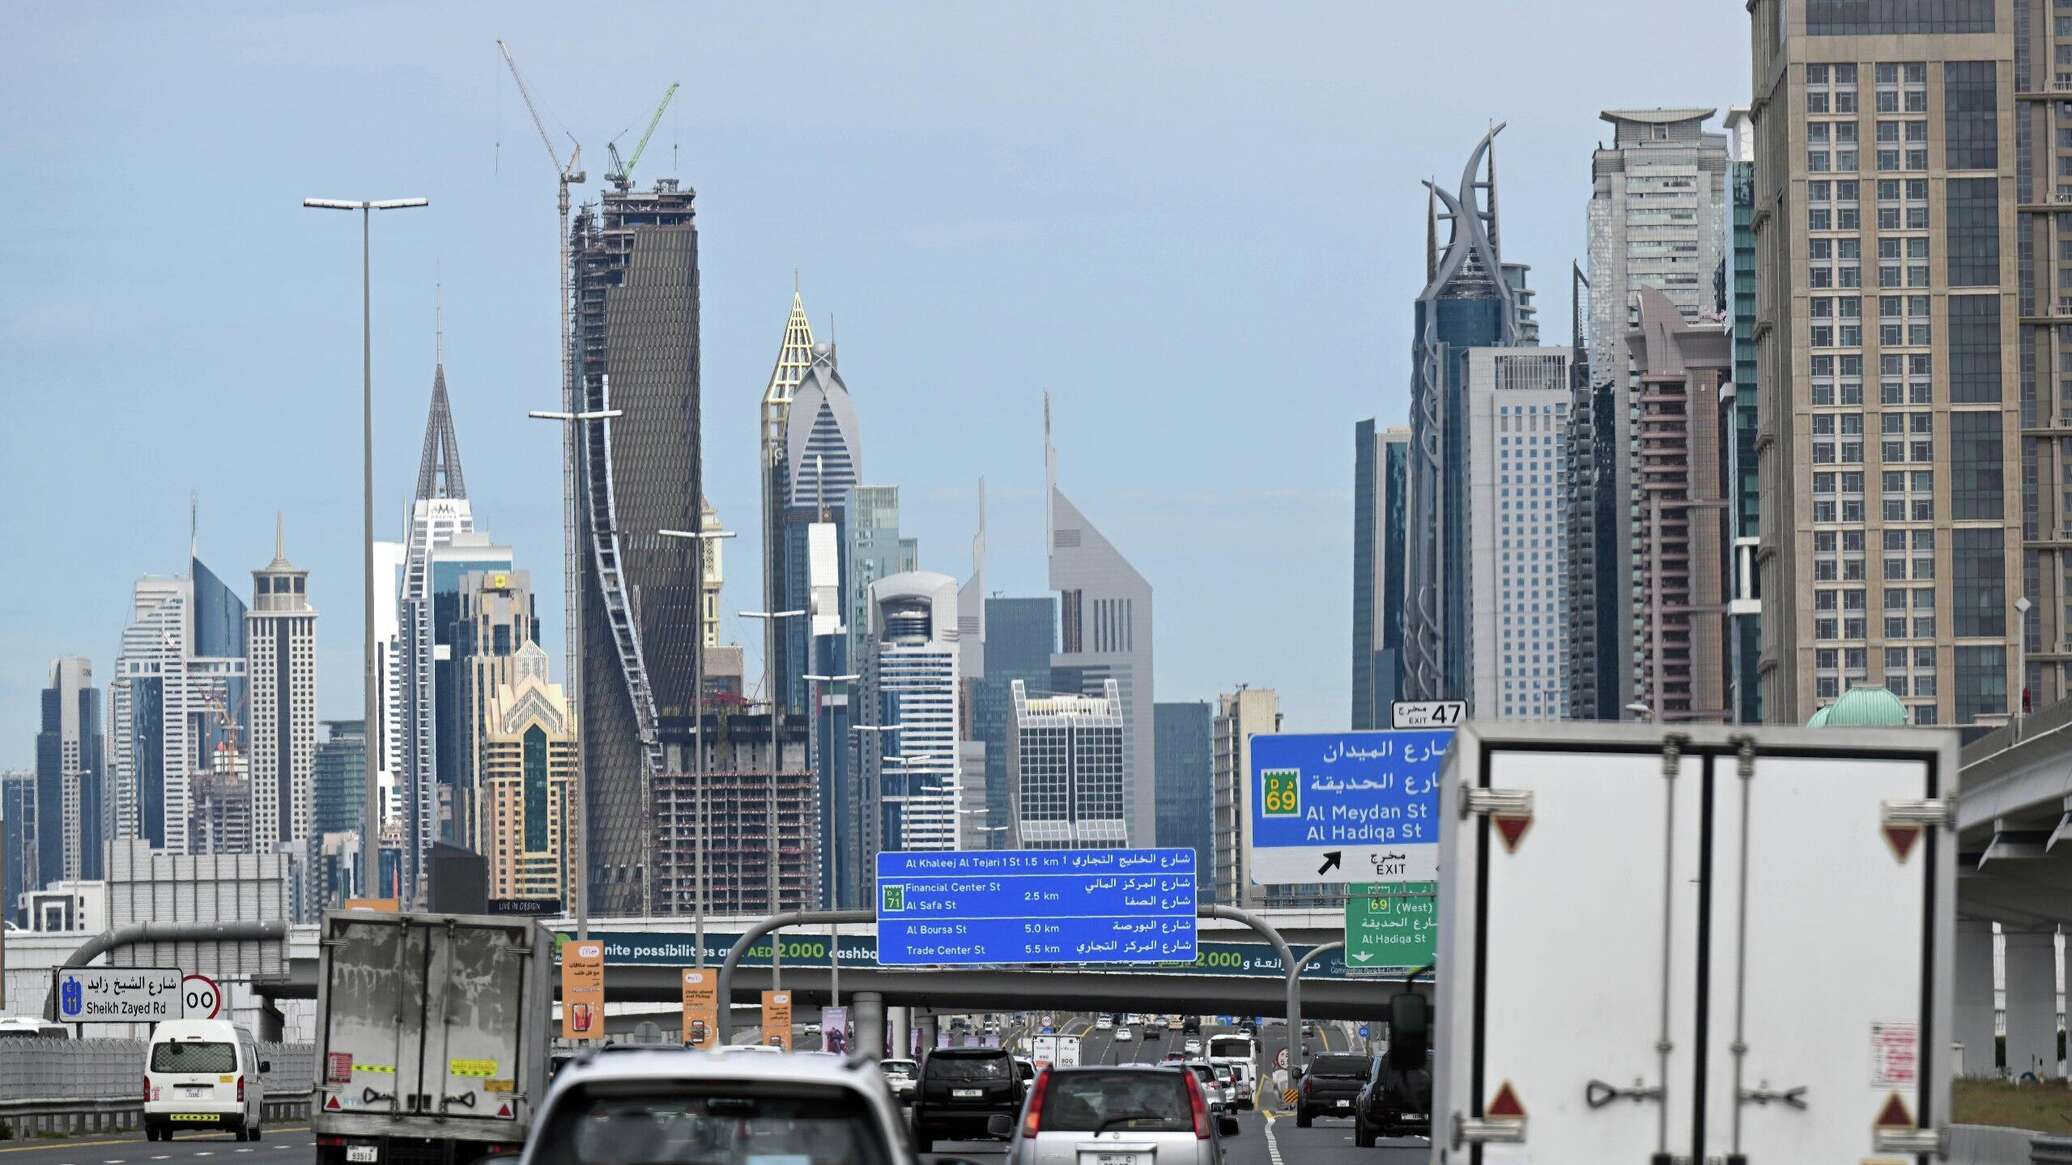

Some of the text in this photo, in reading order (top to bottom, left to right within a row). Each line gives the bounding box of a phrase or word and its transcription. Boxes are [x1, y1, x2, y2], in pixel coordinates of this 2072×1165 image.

[1408, 716, 1427, 725] EXIT
[1431, 704, 1461, 724] 47
[1323, 739, 1393, 763] الميدان
[1311, 771, 1441, 795] ارع الحديقة
[1266, 791, 1297, 811] 69
[1306, 803, 1428, 824] Al Meydan St
[1306, 823, 1422, 843] Al Hadiqa St
[905, 859, 917, 869] Al
[919, 858, 957, 869] Khaleej
[959, 858, 970, 868] Al
[973, 857, 1000, 868] Tejari
[1009, 857, 1021, 867] St
[1025, 857, 1038, 867] 1.5
[1043, 857, 1059, 866] km
[1072, 854, 1114, 868] التجاري
[1118, 853, 1156, 868] الخليج
[1160, 853, 1191, 868] شارع
[1370, 851, 1406, 865] مخرج
[1376, 864, 1407, 876] EXIT
[905, 882, 1001, 892] Financial Center St
[1084, 878, 1191, 894] شارع المركز المالي
[887, 897, 900, 908] 71
[1024, 891, 1059, 901] 2.5 km
[1124, 895, 1191, 909] شارع الصفا
[906, 900, 957, 910] Al Safa St
[1371, 898, 1388, 910] 69
[1396, 902, 1433, 914] (West)
[906, 923, 1060, 935] Al Boursa St 5.0 km
[1112, 920, 1191, 934] شارع البورصة
[1361, 917, 1408, 930] الحديقة
[1362, 934, 1426, 945] Al Hadiqa St
[604, 944, 631, 956] nite
[633, 944, 715, 959] possibilites
[747, 947, 774, 958] AED
[906, 944, 1060, 955] Trade Center St 5.5 km
[1076, 940, 1192, 955] شارع المركز التجاري
[87, 975, 177, 996] شارع الشيخ زايد
[67, 996, 78, 1012] 11
[186, 991, 214, 1009] 00
[86, 1002, 166, 1018] Sheikh Zayed Rd
